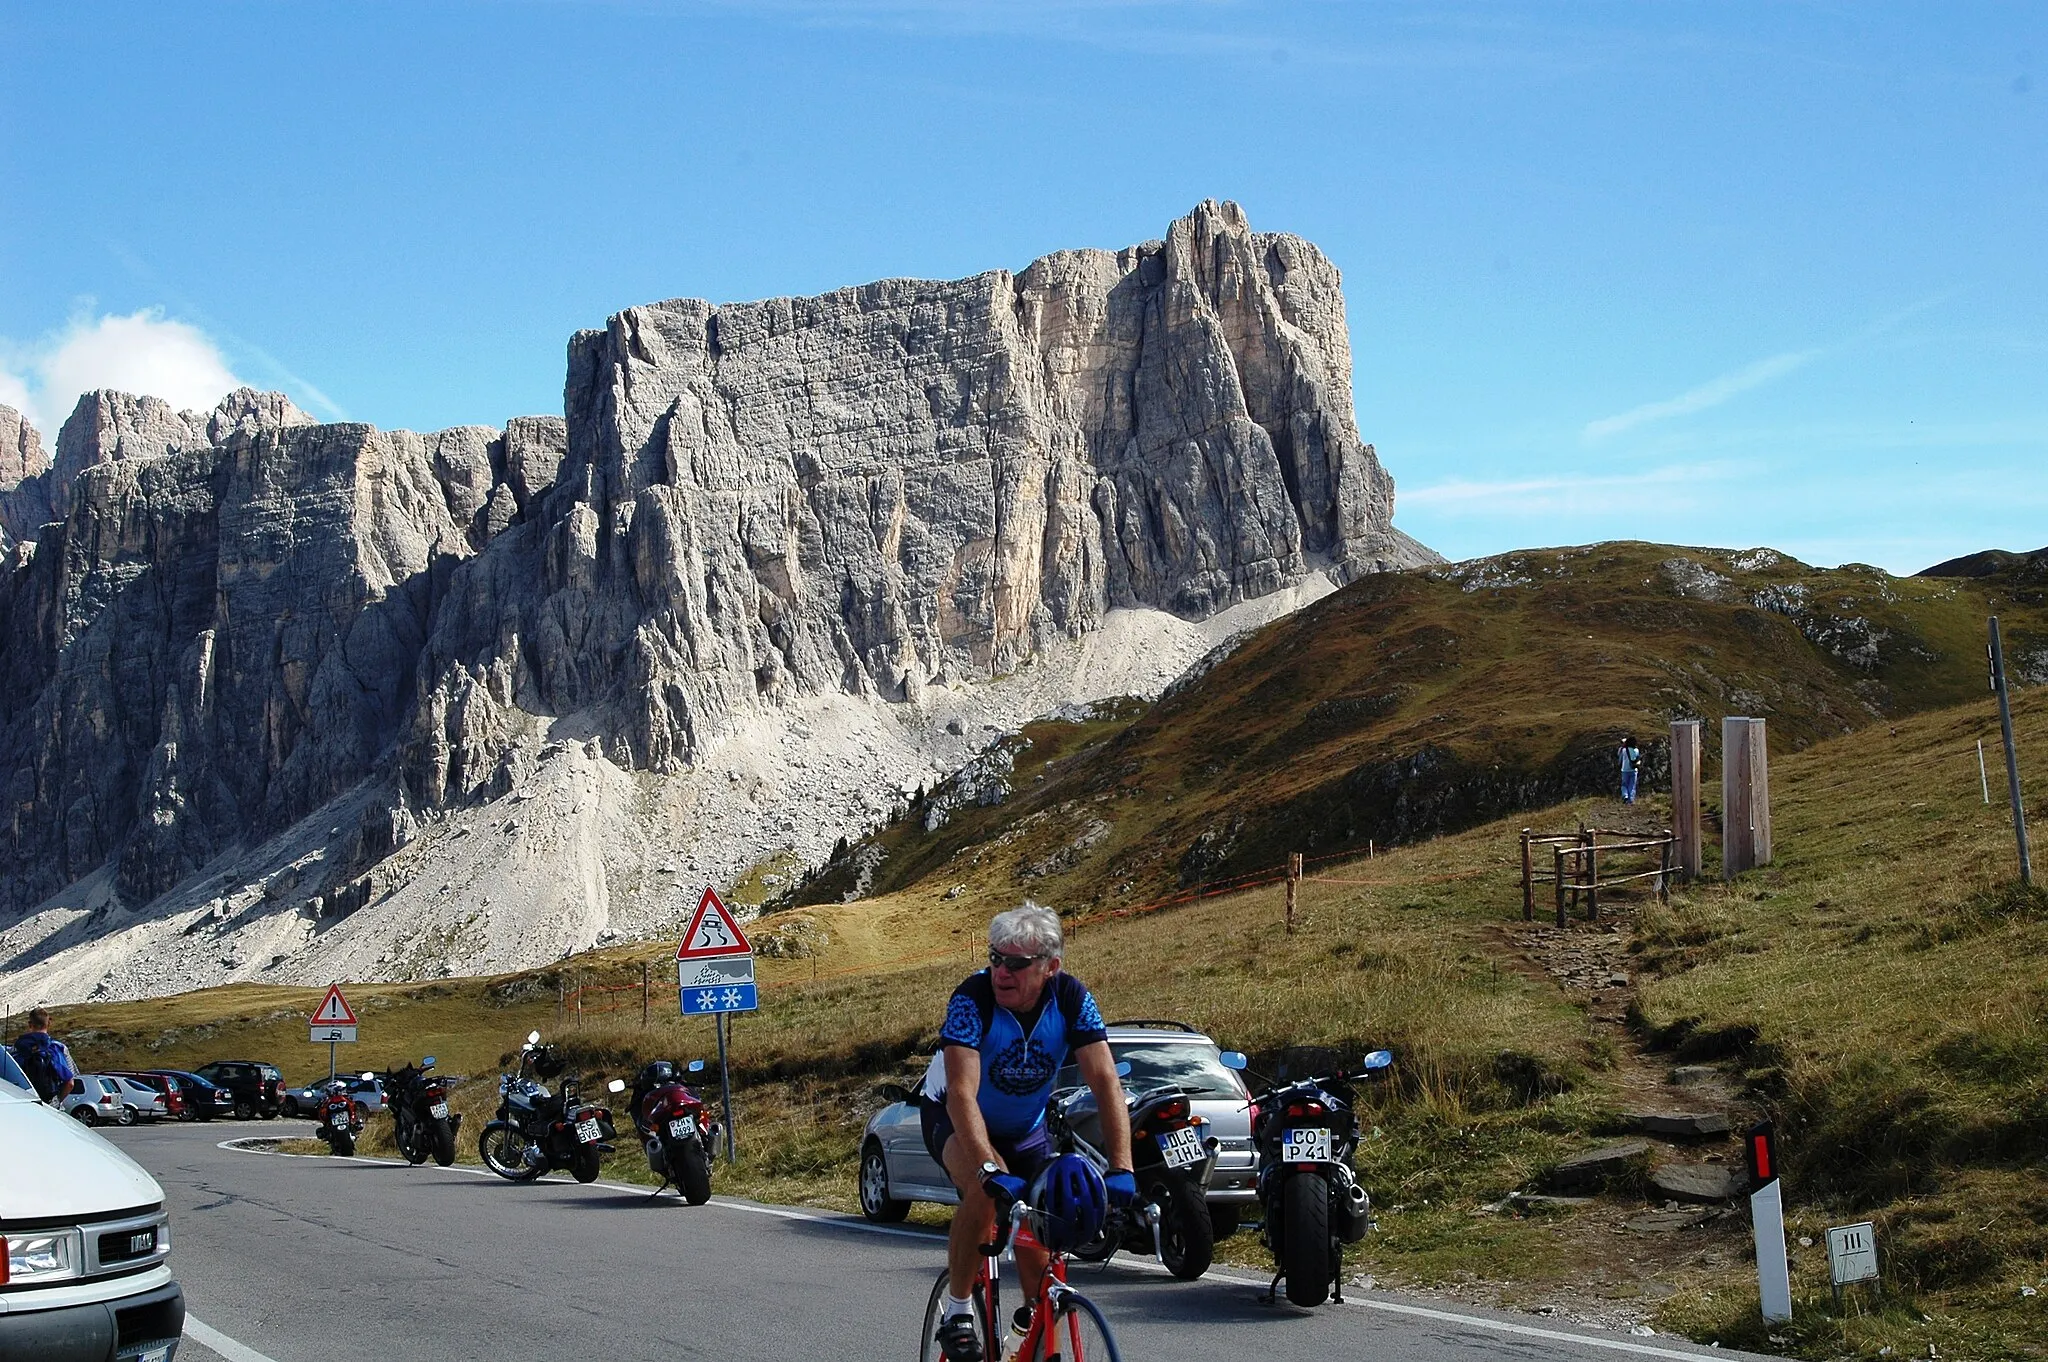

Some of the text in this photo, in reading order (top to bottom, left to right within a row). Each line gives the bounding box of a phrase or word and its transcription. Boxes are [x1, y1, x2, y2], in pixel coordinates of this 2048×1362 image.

[580, 1121, 593, 1132] ES
[1167, 1129, 1196, 1148] DLG
[1293, 1130, 1317, 1144] CO
[1290, 1145, 1328, 1160] P 41
[1844, 1232, 1861, 1250] III
